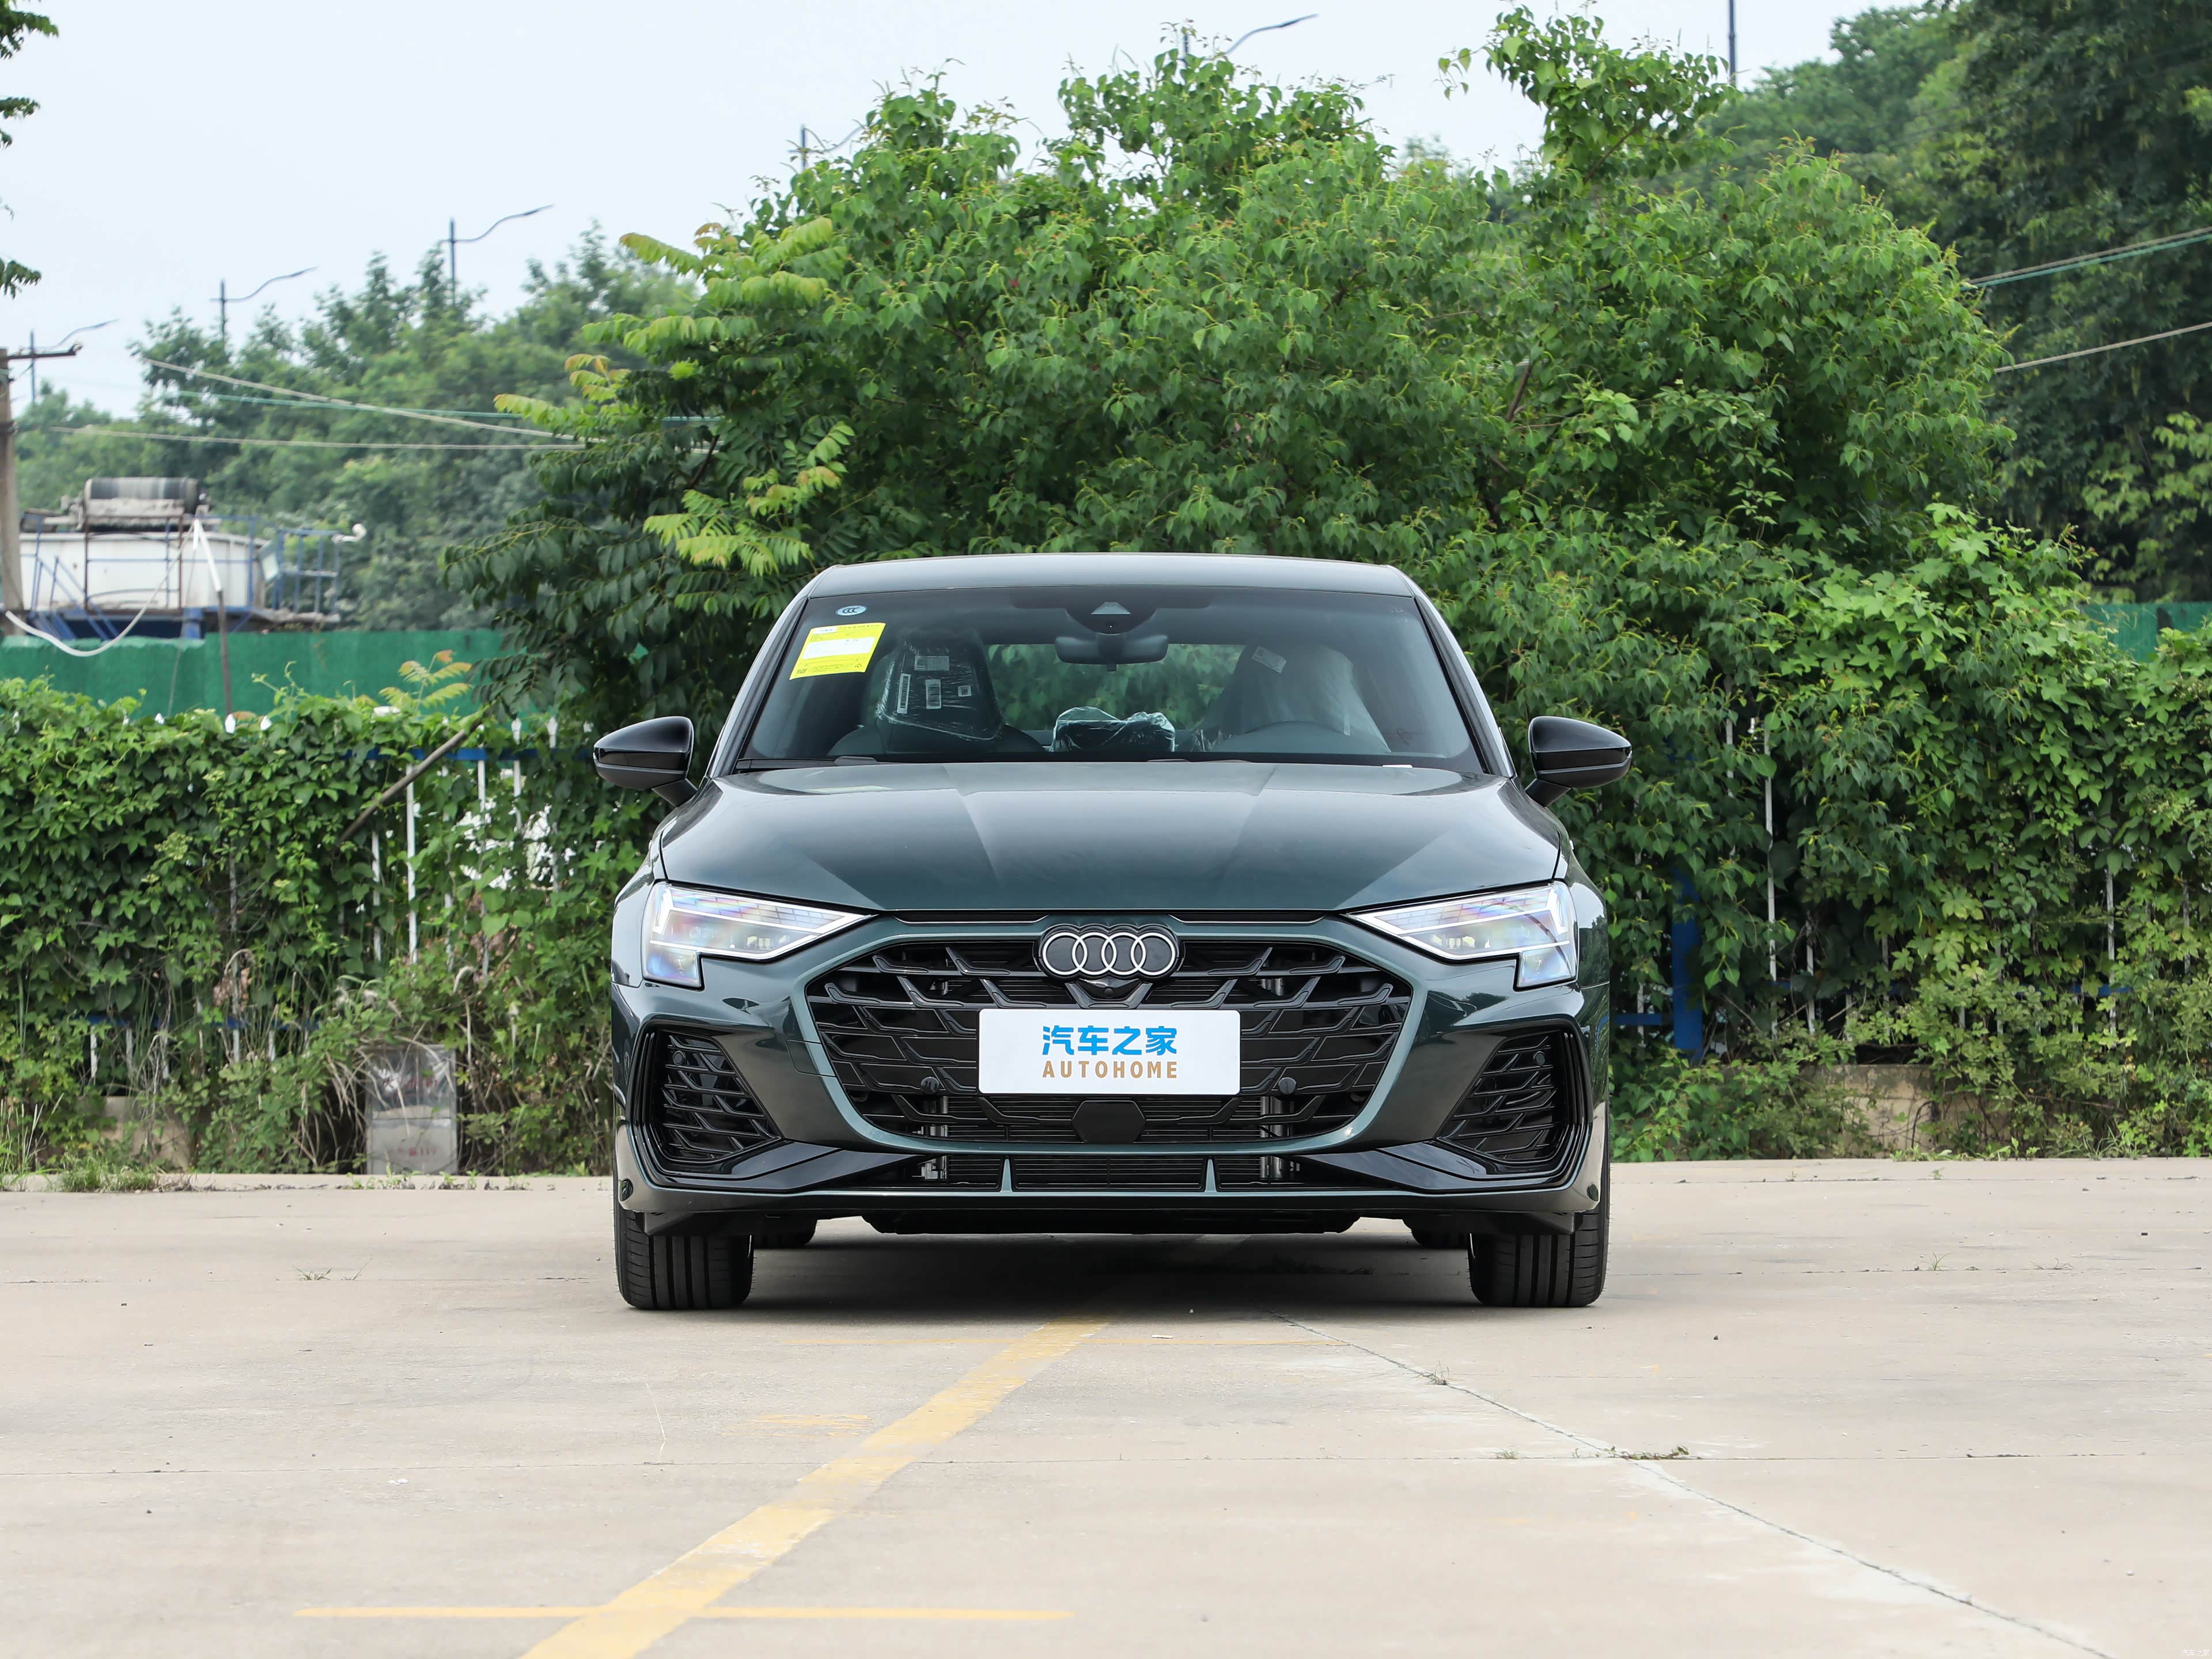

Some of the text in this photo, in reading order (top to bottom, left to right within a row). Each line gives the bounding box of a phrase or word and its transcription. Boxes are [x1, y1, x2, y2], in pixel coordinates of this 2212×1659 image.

[1042, 1025, 1177, 1055] 汽车之家
[1042, 1061, 1177, 1078] AUTOHOME
